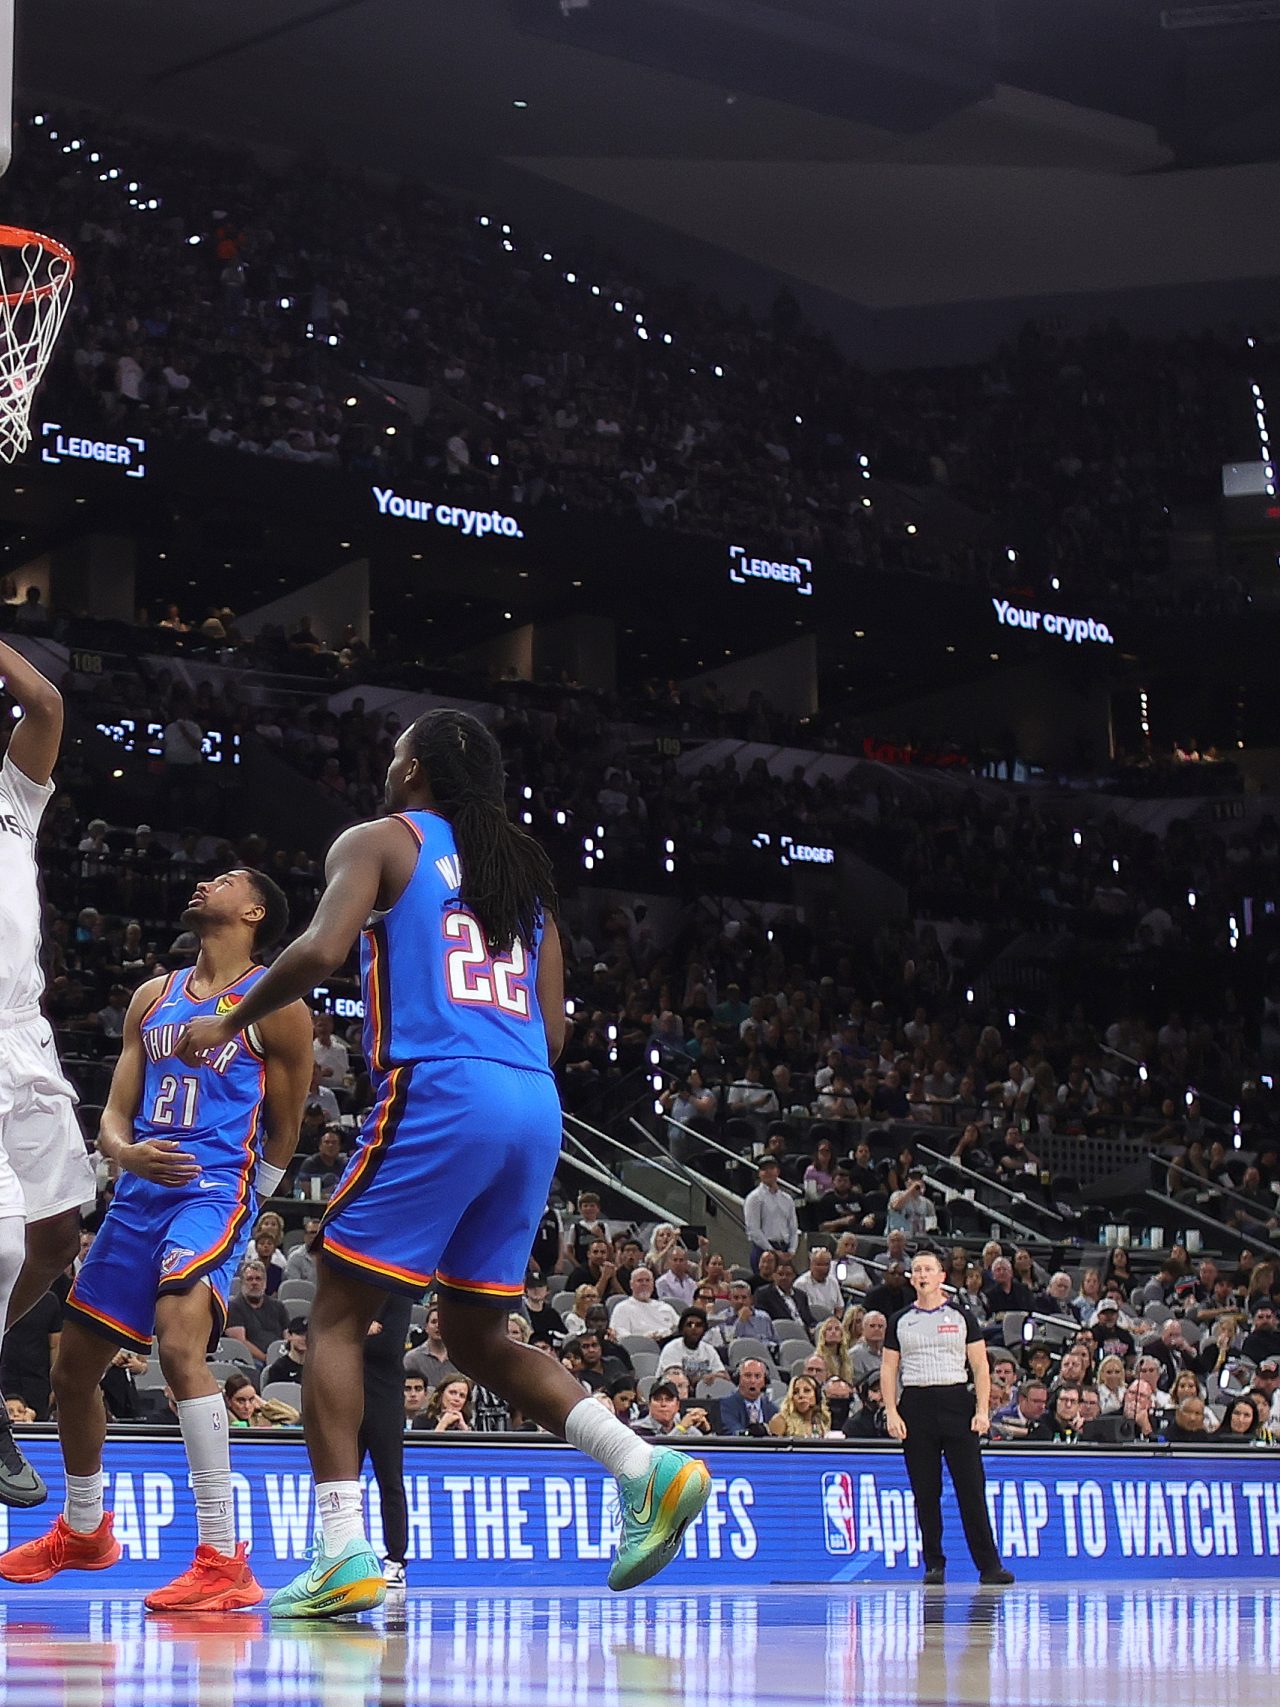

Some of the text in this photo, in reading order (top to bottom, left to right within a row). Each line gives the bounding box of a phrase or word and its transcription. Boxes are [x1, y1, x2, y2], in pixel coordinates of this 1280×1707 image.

[56, 435, 131, 465] LEDGER
[372, 486, 524, 538] Your crypto.
[741, 557, 801, 584] LEDGER
[992, 598, 1114, 645] Your crypto.
[789, 844, 834, 864] LEDGER
[444, 912, 530, 1017] 22
[153, 1076, 197, 1126] 21
[102, 1472, 174, 1559] AP
[443, 1476, 534, 1559] THE
[1056, 1480, 1107, 1557] TO
[1112, 1480, 1238, 1557] WATCH
